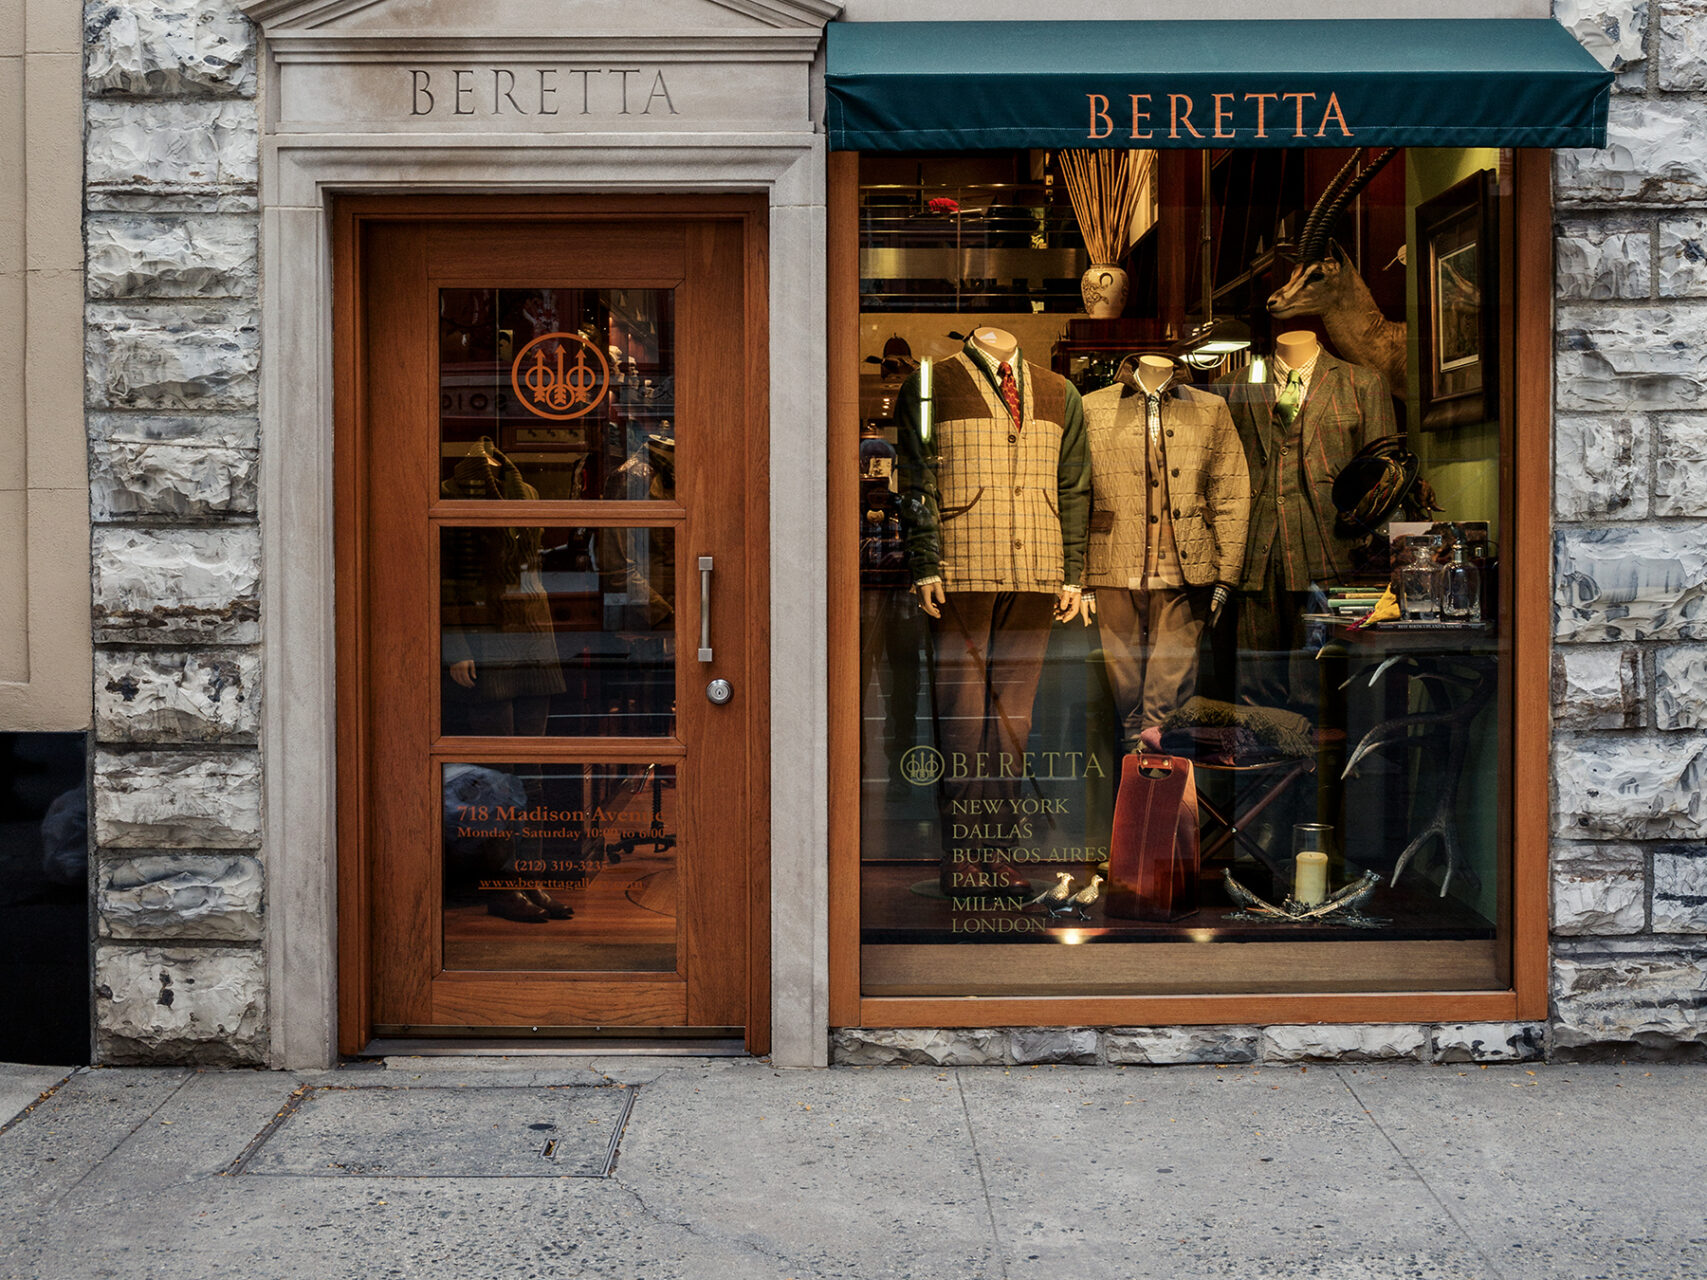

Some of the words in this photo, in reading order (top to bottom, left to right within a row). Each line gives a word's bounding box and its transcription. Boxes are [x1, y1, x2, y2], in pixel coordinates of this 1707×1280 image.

[409, 69, 681, 116] BERETTA
[1085, 91, 1355, 139] BERETTA
[951, 751, 1107, 779] BERETTA
[456, 805, 489, 822] 718
[495, 805, 585, 822] Madison
[591, 805, 665, 822] Avenue
[952, 799, 1004, 815] NEW
[1009, 798, 1070, 815] YORK
[457, 826, 513, 841] Monday
[521, 827, 581, 841] Saturday
[622, 829, 635, 839] to
[952, 823, 1033, 840] DALLAS
[952, 847, 1042, 864] BUENOS
[1048, 846, 1108, 863] AIRES
[514, 860, 547, 872] (212)
[952, 871, 1010, 888] PARIS
[952, 895, 1024, 912] MILAN
[952, 918, 1047, 934] LONDON
